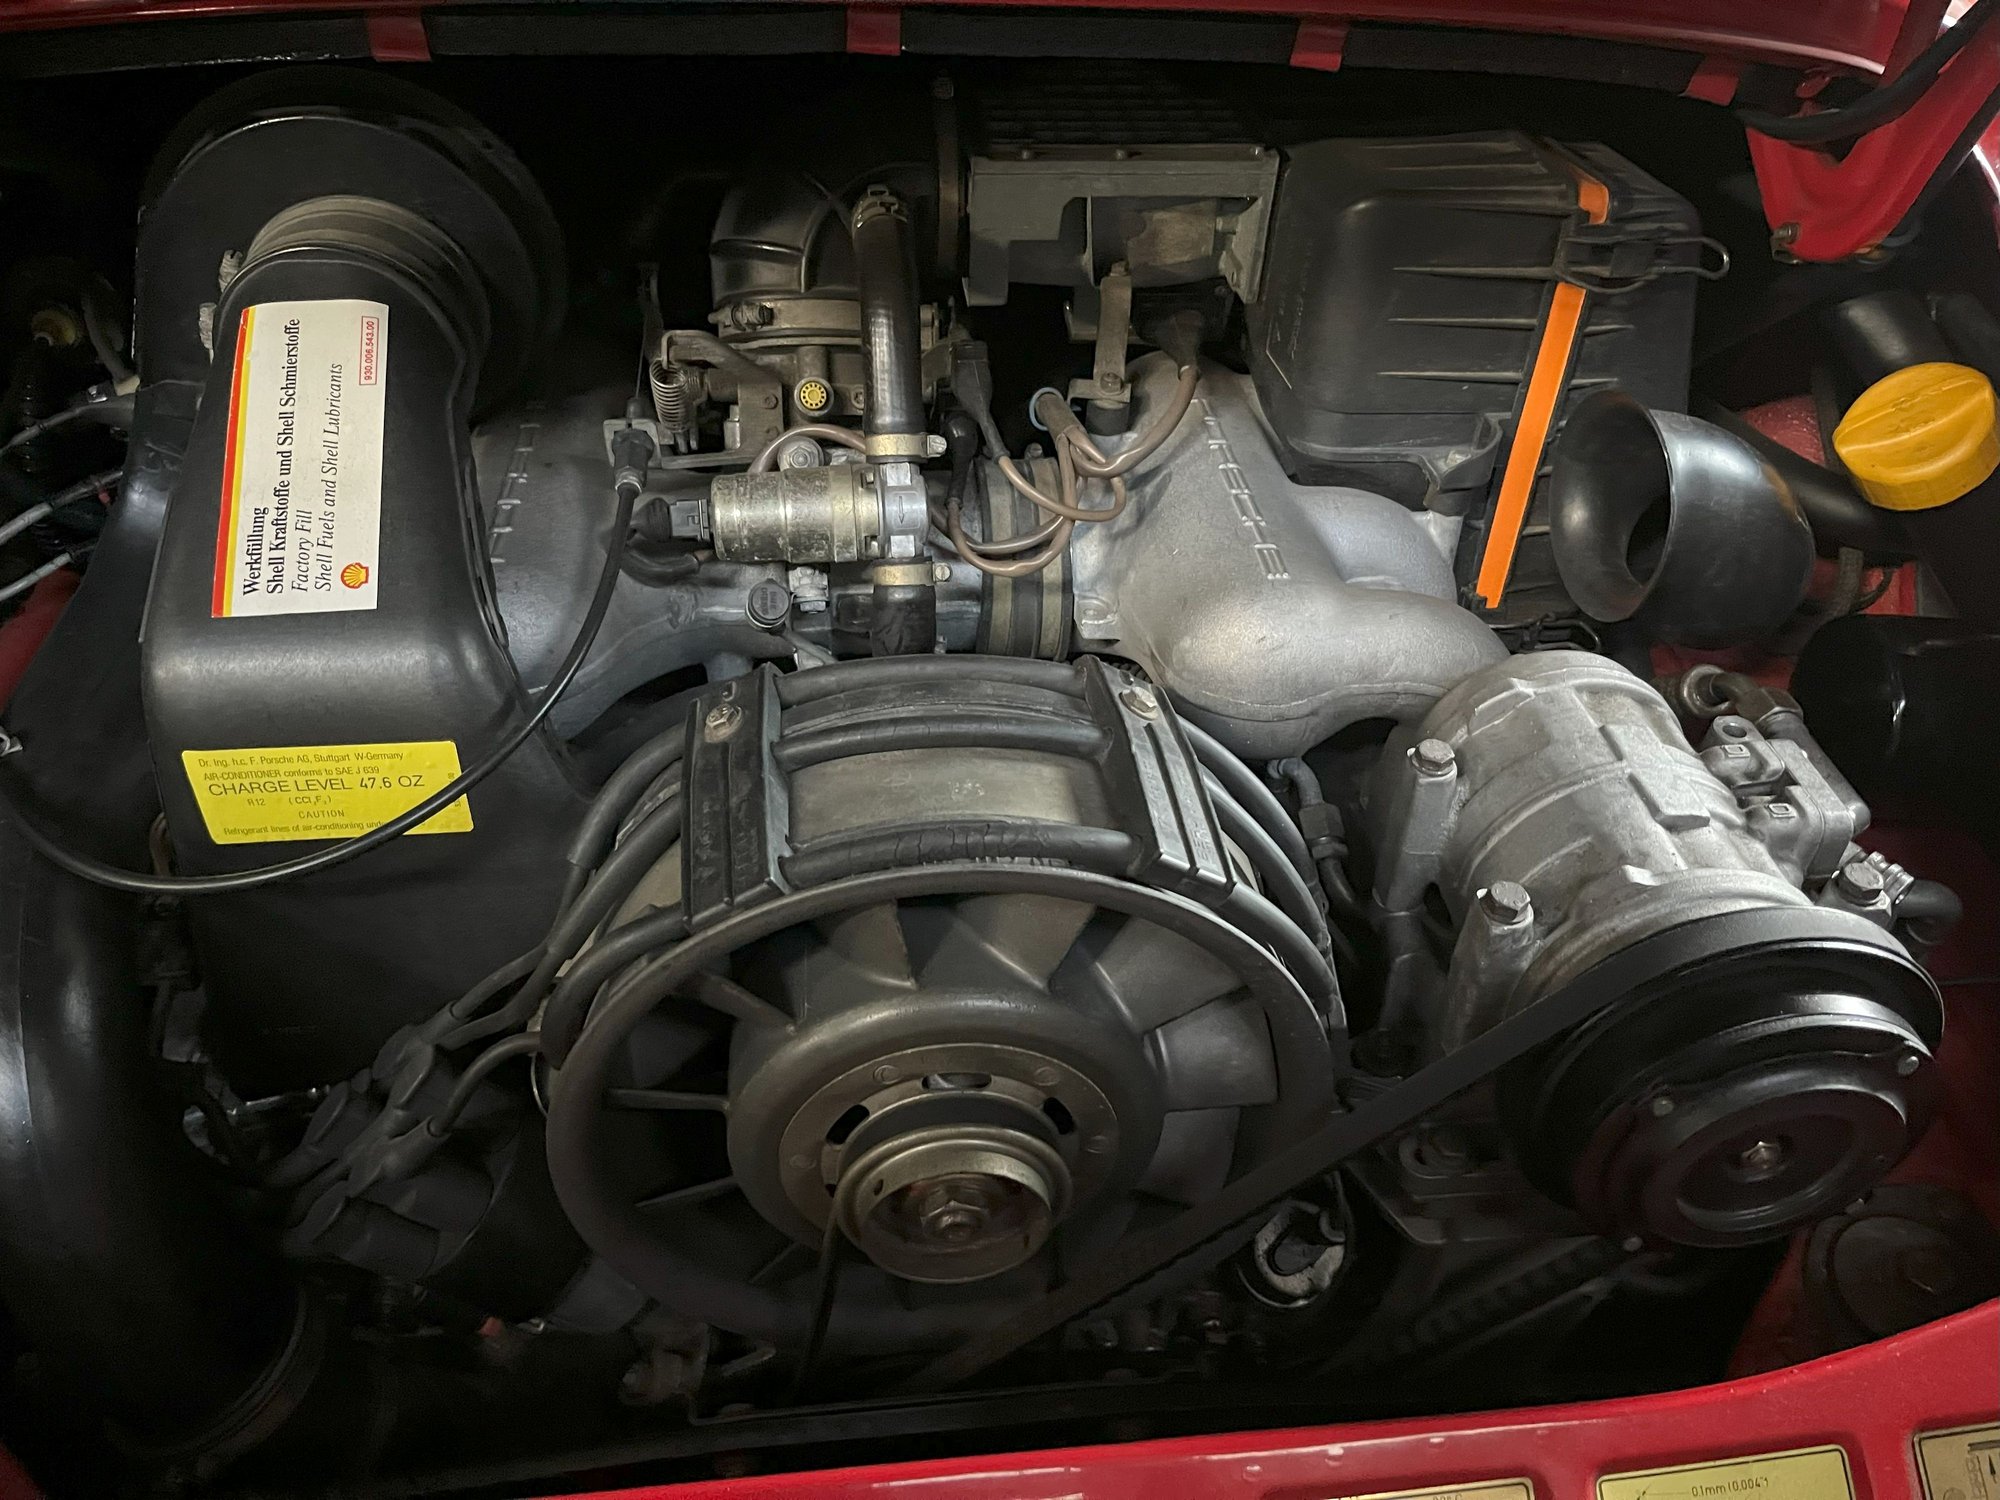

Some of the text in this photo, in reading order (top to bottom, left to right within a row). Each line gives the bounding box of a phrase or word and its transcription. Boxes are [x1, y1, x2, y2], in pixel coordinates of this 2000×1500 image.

[363, 320, 375, 381] 930.006.543.00
[267, 318, 300, 594] Shell Kraftstoffe und Shell Schmierstoffe
[315, 363, 343, 591] Shell Fuels and Shell Lubricants
[243, 506, 268, 595] Werkfüllung
[292, 509, 313, 591] Factory Fill
[199, 758, 211, 767] Dr.
[214, 758, 229, 768] Ing.
[250, 756, 258, 764] F.
[260, 756, 294, 764] Porsche
[297, 755, 312, 764] AG,
[314, 753, 349, 763] Stuttgart
[354, 752, 403, 761] W-Germany
[204, 770, 280, 781] AIR-CONDITIONER
[284, 768, 322, 777] conforms
[325, 767, 333, 775] to
[335, 767, 353, 775] SAE
[364, 766, 379, 774] 639
[209, 775, 425, 796] CHARGE LEVEL 47.6 OZ
[292, 824, 299, 832] of
[303, 822, 364, 832] air-conditioning
[366, 821, 385, 829] und
[299, 809, 344, 819] CAUTION
